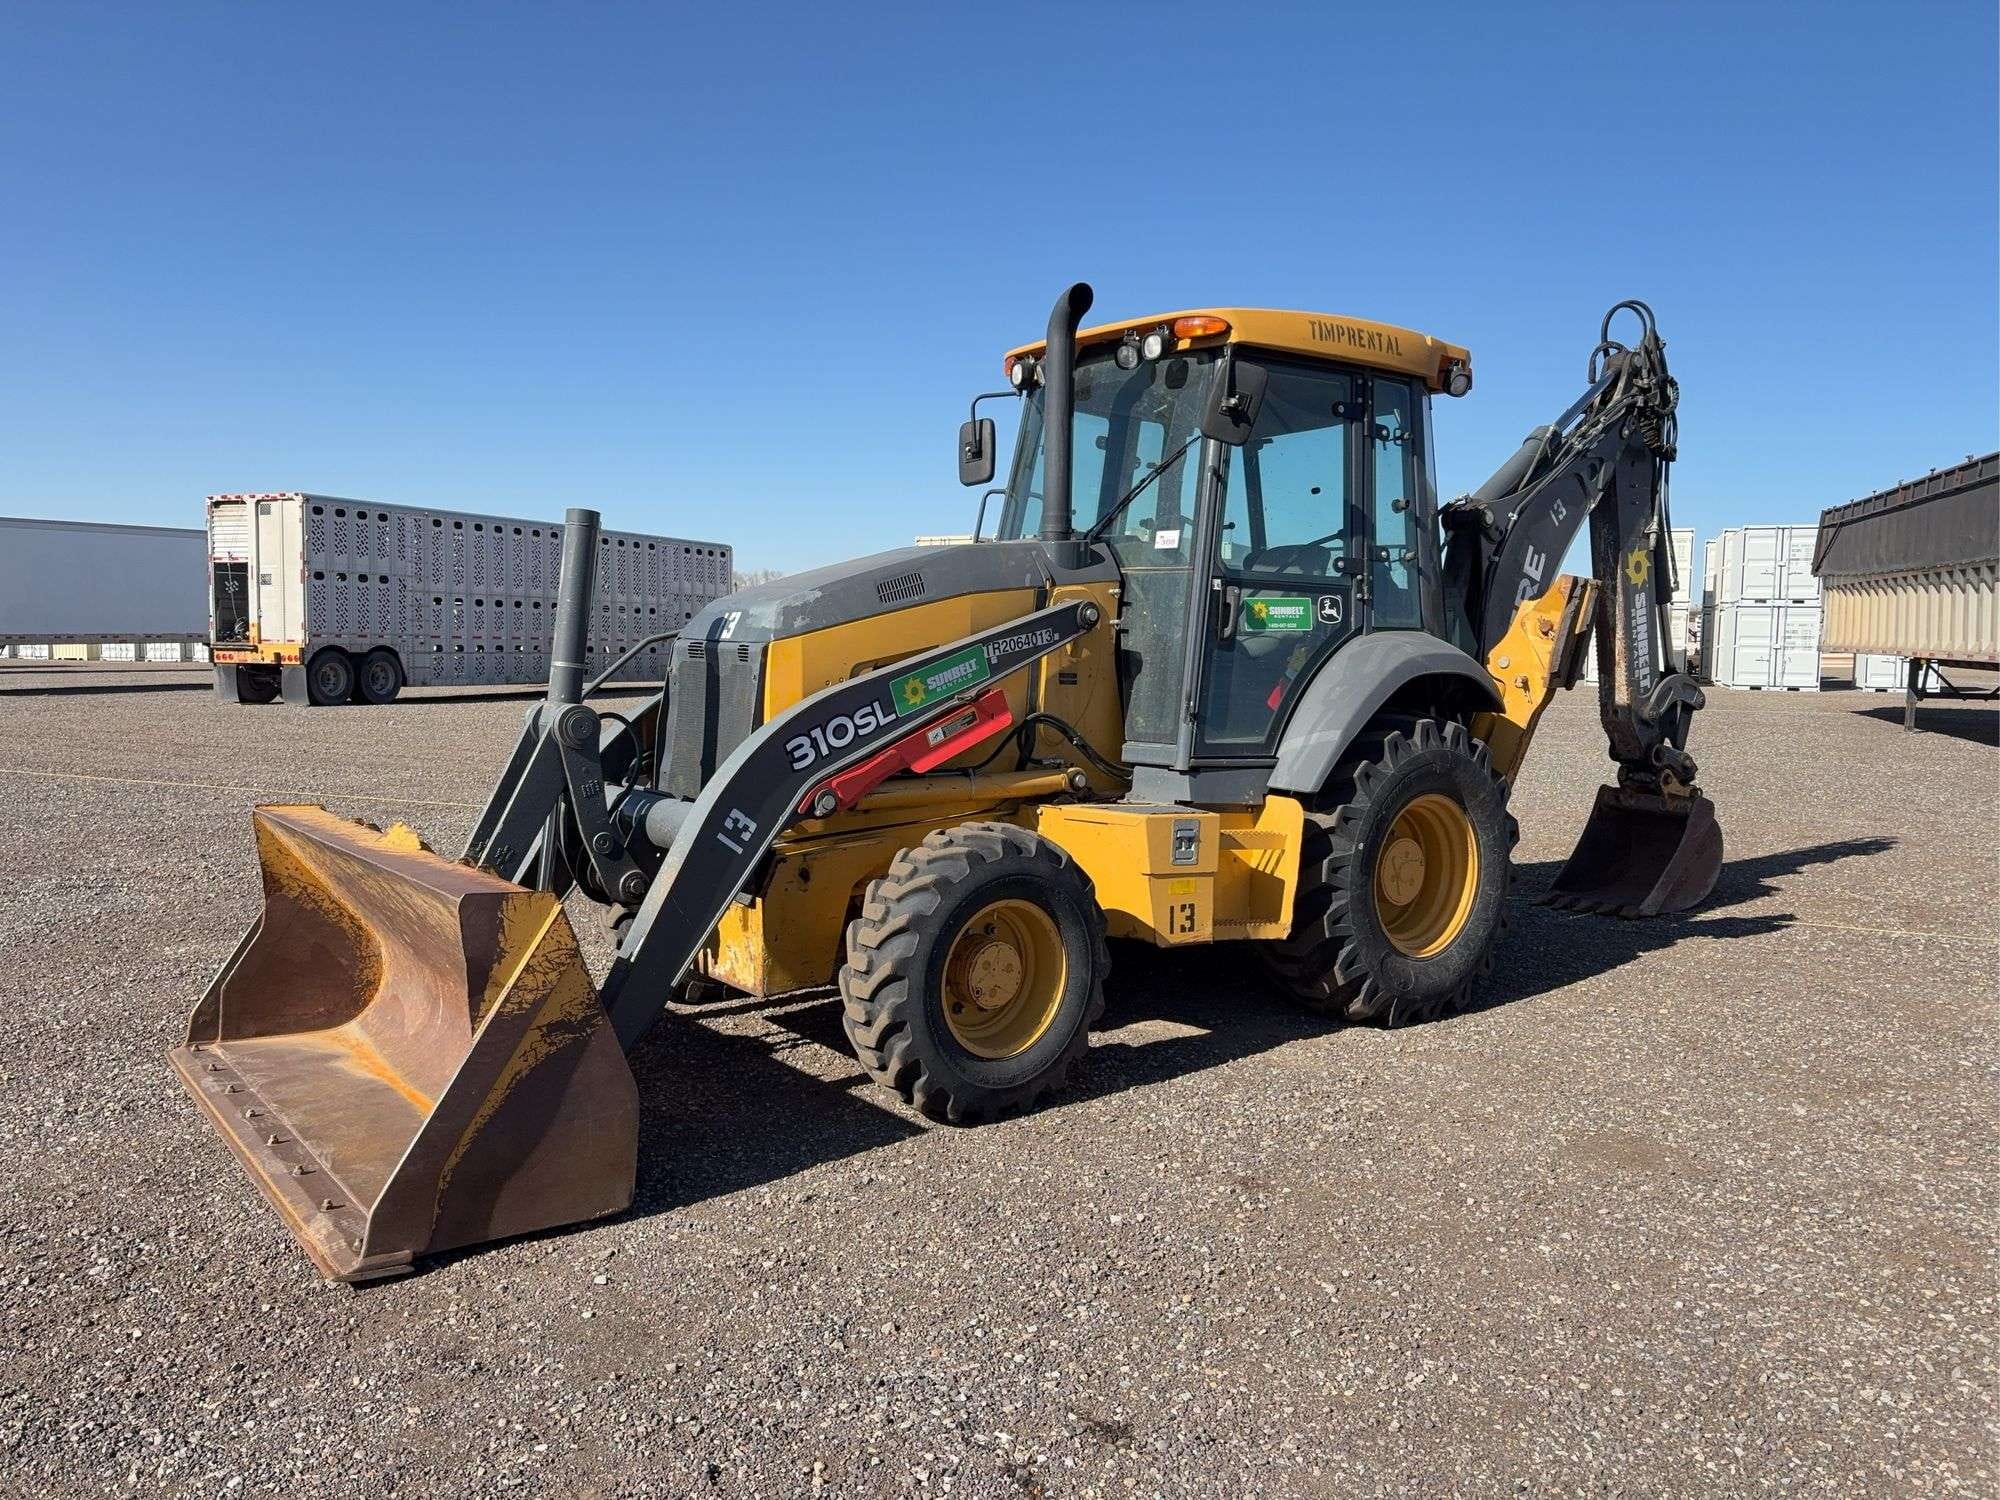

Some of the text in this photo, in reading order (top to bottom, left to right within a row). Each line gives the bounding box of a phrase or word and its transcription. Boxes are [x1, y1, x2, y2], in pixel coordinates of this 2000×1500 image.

[1308, 320, 1402, 356] TIMPRENTAL
[1550, 498, 1567, 527] 13
[1269, 606, 1304, 615] SUNBELT
[984, 628, 1055, 658] TR2064013
[1635, 592, 1651, 689] SUNBELT
[926, 658, 977, 690] SUNBELT
[785, 700, 897, 771] 310SL
[717, 808, 758, 855] 13
[1169, 903, 1196, 934] 13
